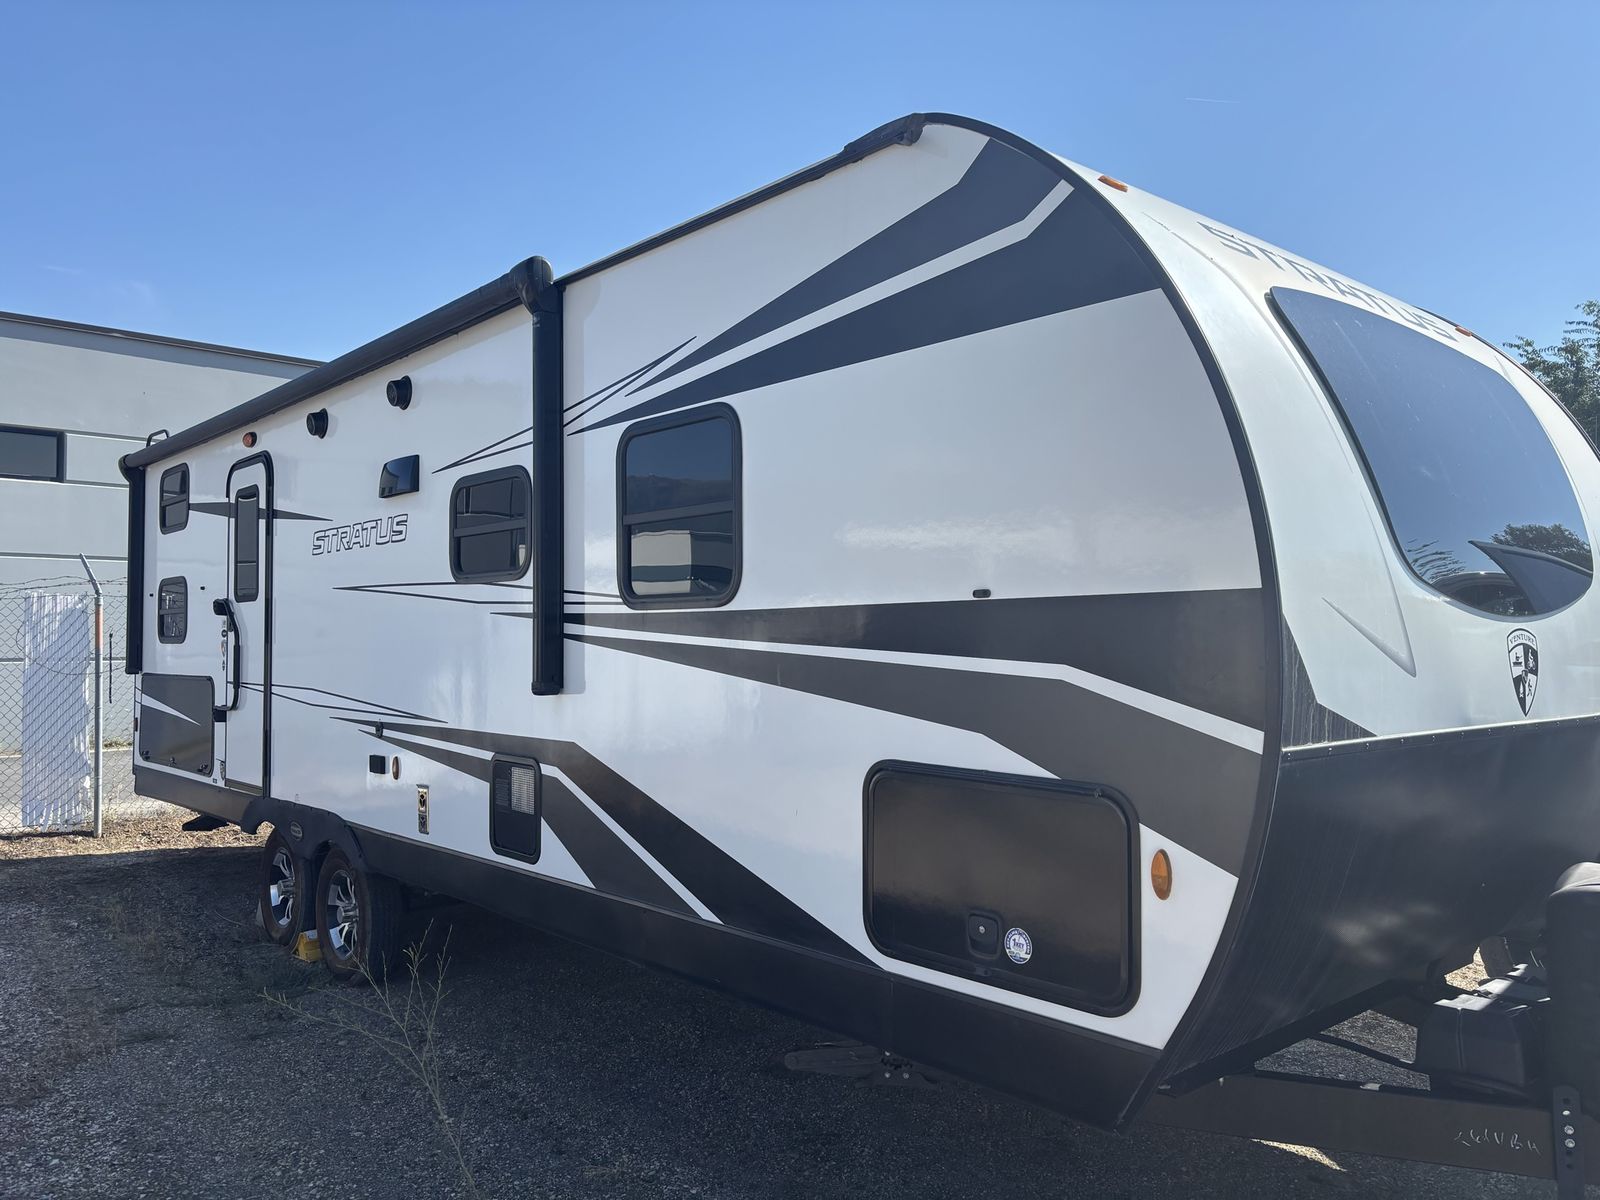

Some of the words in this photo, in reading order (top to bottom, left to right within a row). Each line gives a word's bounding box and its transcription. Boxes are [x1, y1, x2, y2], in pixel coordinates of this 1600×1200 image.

[1197, 221, 1460, 343] STRATUS
[311, 513, 409, 556] STRATUS
[1509, 633, 1535, 645] VENTURE
